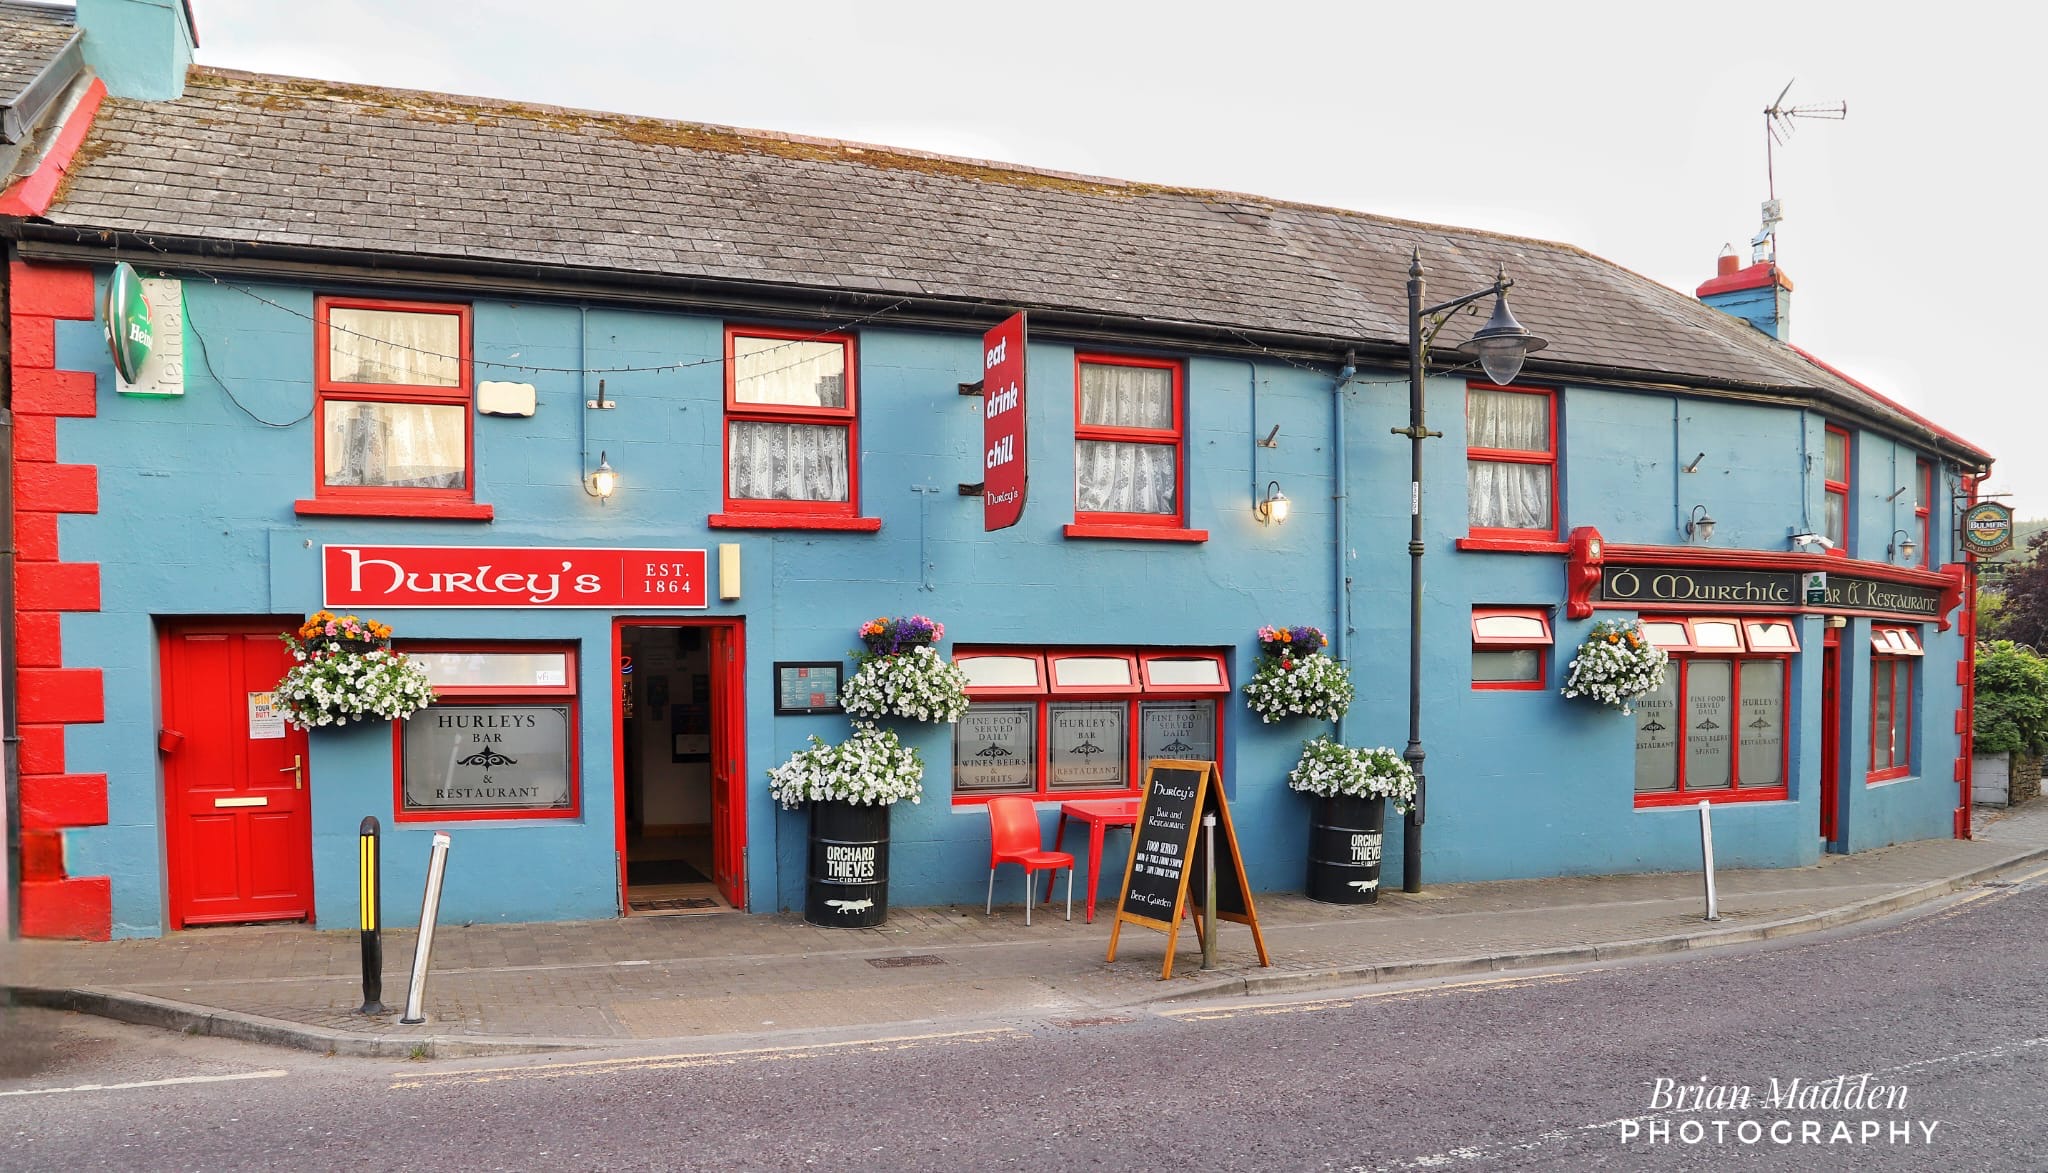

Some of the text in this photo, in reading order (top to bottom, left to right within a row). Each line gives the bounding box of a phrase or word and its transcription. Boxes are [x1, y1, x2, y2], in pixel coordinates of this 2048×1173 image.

[986, 336, 1006, 370] eat
[986, 381, 1018, 419] drink
[986, 434, 1014, 469] chill
[646, 563, 690, 577] EST.
[644, 580, 691, 593] 1864
[1611, 568, 1640, 597] Ó
[254, 695, 270, 705] BIN
[438, 714, 536, 728] HURLEYS
[966, 717, 1022, 725] FINE FOOD
[1060, 719, 1115, 728] HURLEY'S
[1160, 721, 1194, 729] SERVED
[975, 725, 1013, 733] SERVED
[1163, 729, 1192, 737] DAILY
[473, 733, 503, 743] BAR
[978, 733, 1009, 741] DAILY
[961, 758, 1026, 767] WINES BEERS
[1057, 766, 1117, 775] RESTAURANT
[483, 775, 493, 784] &
[974, 775, 1012, 783] SPIRITS
[436, 786, 539, 799] RESTAURANT
[1146, 839, 1178, 855] FOOD SERVED
[827, 846, 875, 861] ORCHARD
[827, 861, 875, 877] THIEVES
